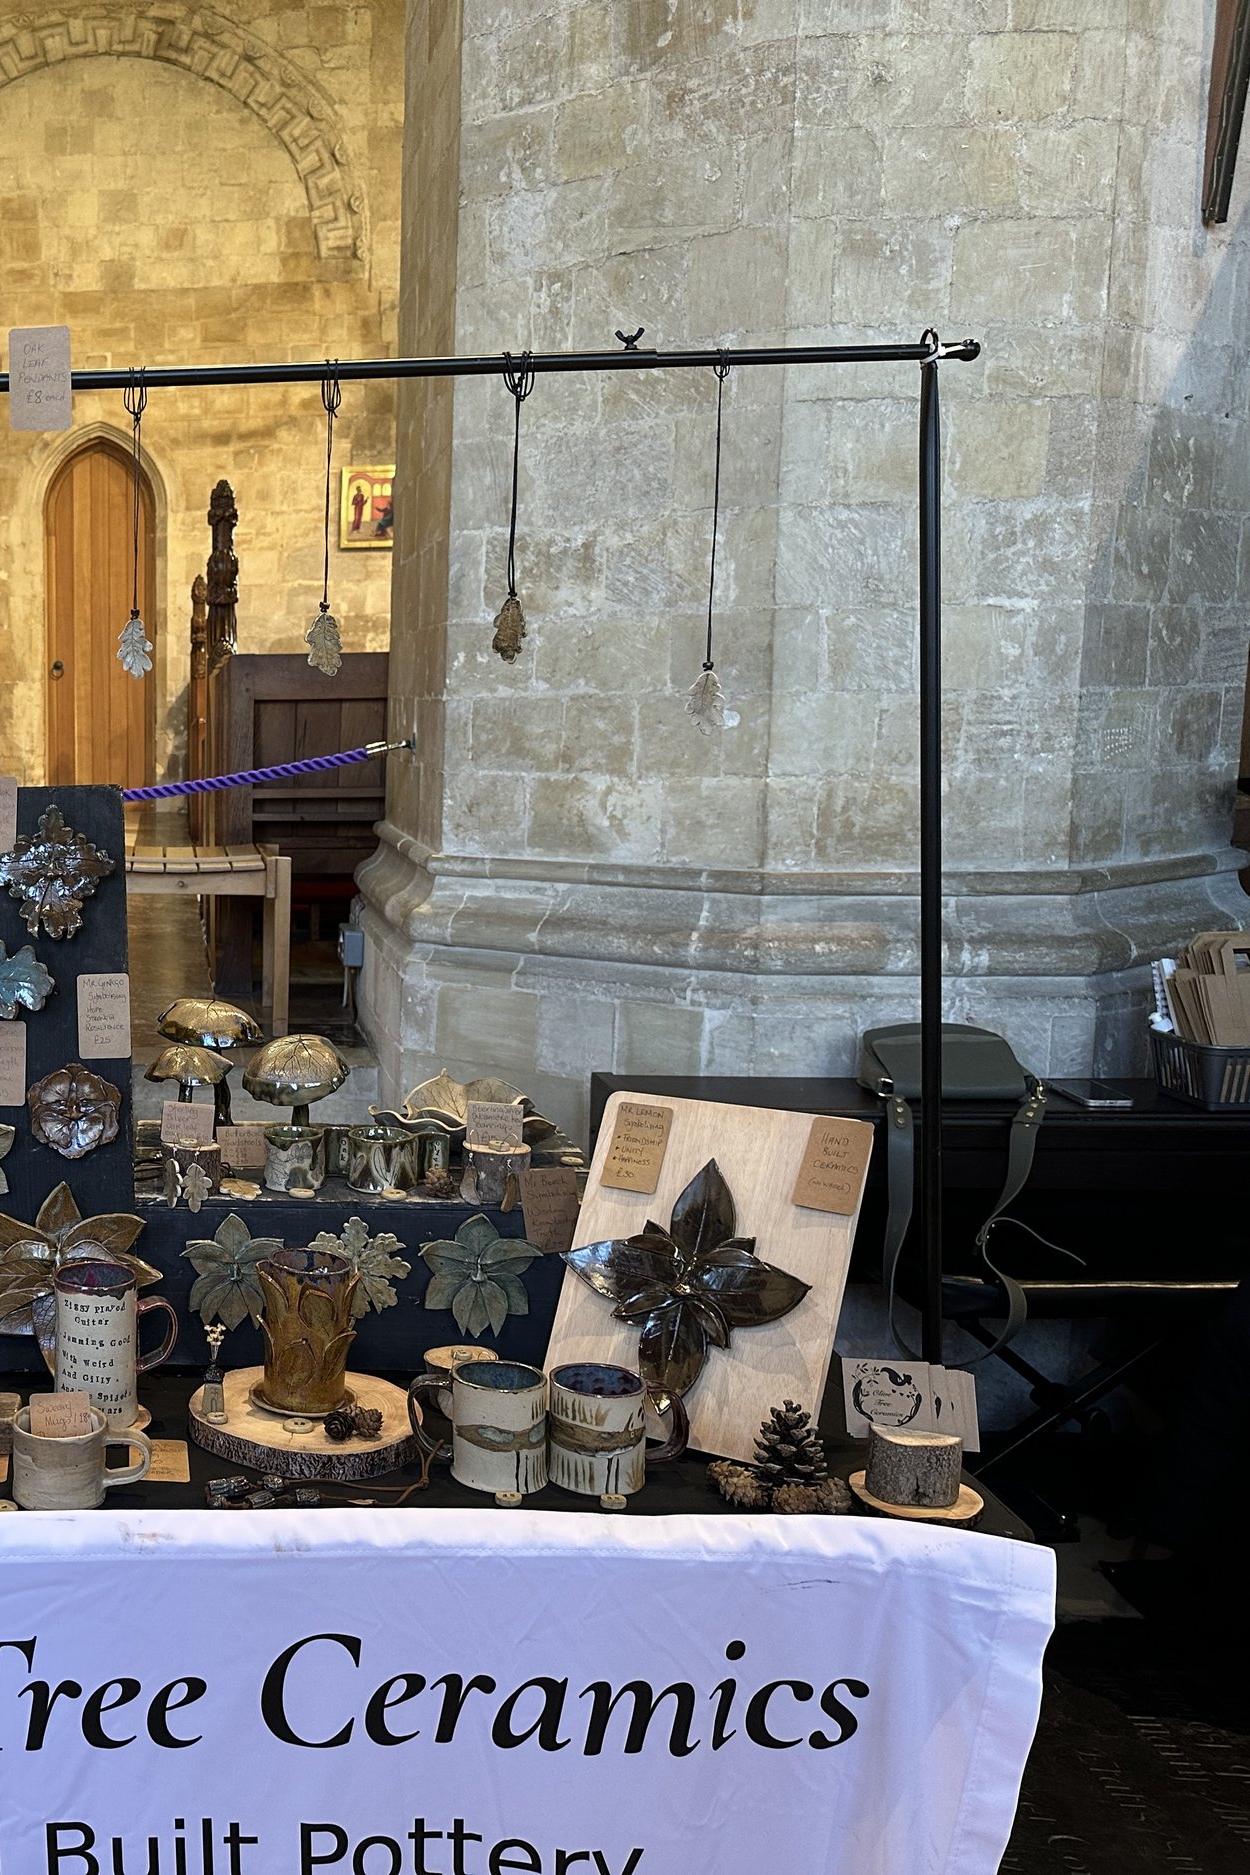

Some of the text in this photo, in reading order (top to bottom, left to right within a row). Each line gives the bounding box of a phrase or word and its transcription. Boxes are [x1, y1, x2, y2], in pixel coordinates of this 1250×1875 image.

[23, 343, 45, 355] OAK
[26, 389, 43, 404] £8
[94, 1034, 111, 1045] £25
[635, 1106, 665, 1119] LEMON
[820, 1131, 850, 1146] HAND
[822, 1146, 850, 1158] BUILT
[812, 1159, 859, 1175] CERAMICS
[872, 1389, 892, 1398] Olive
[260, 1633, 870, 1758] Ceramics
[46, 1818, 259, 1875] Built
